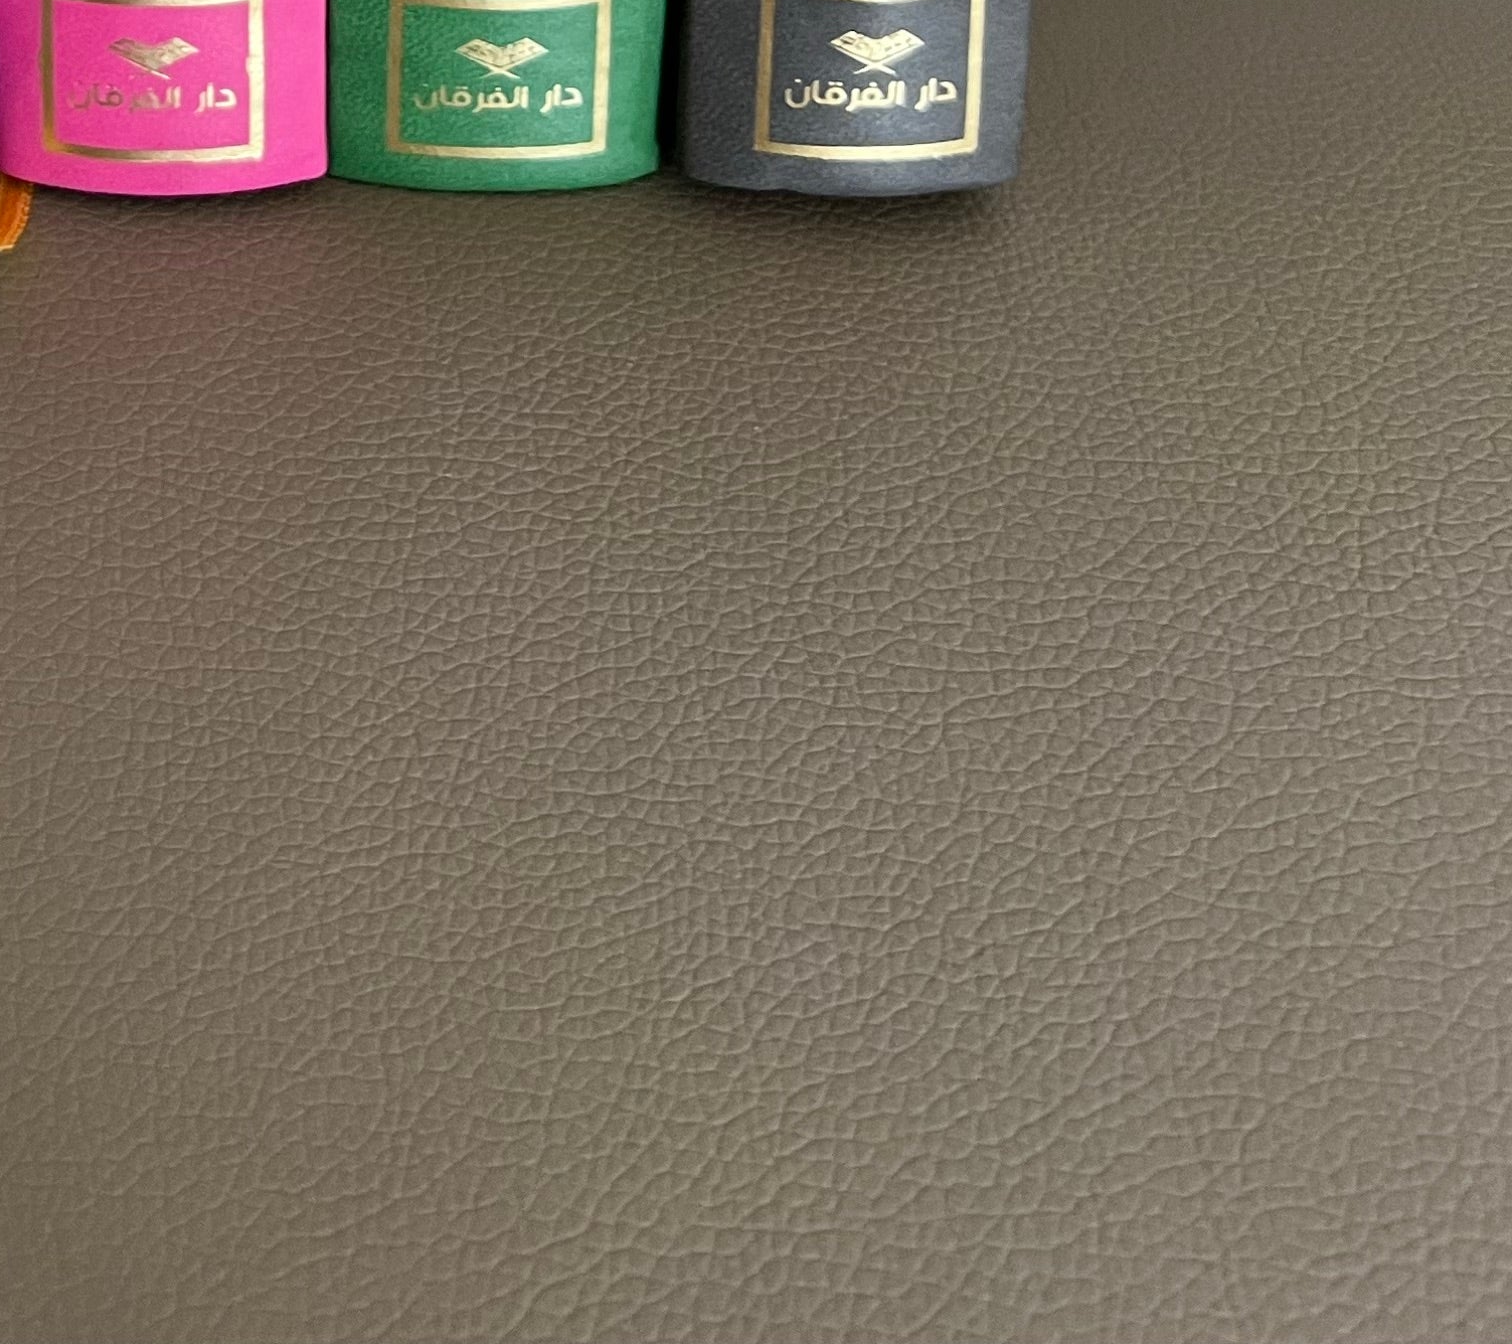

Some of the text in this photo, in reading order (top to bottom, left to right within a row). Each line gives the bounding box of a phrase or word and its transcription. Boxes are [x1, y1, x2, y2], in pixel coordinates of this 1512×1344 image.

[193, 82, 238, 116] دار
[414, 82, 584, 114] دار الفرقان
[784, 77, 958, 112] دار الفرقان
